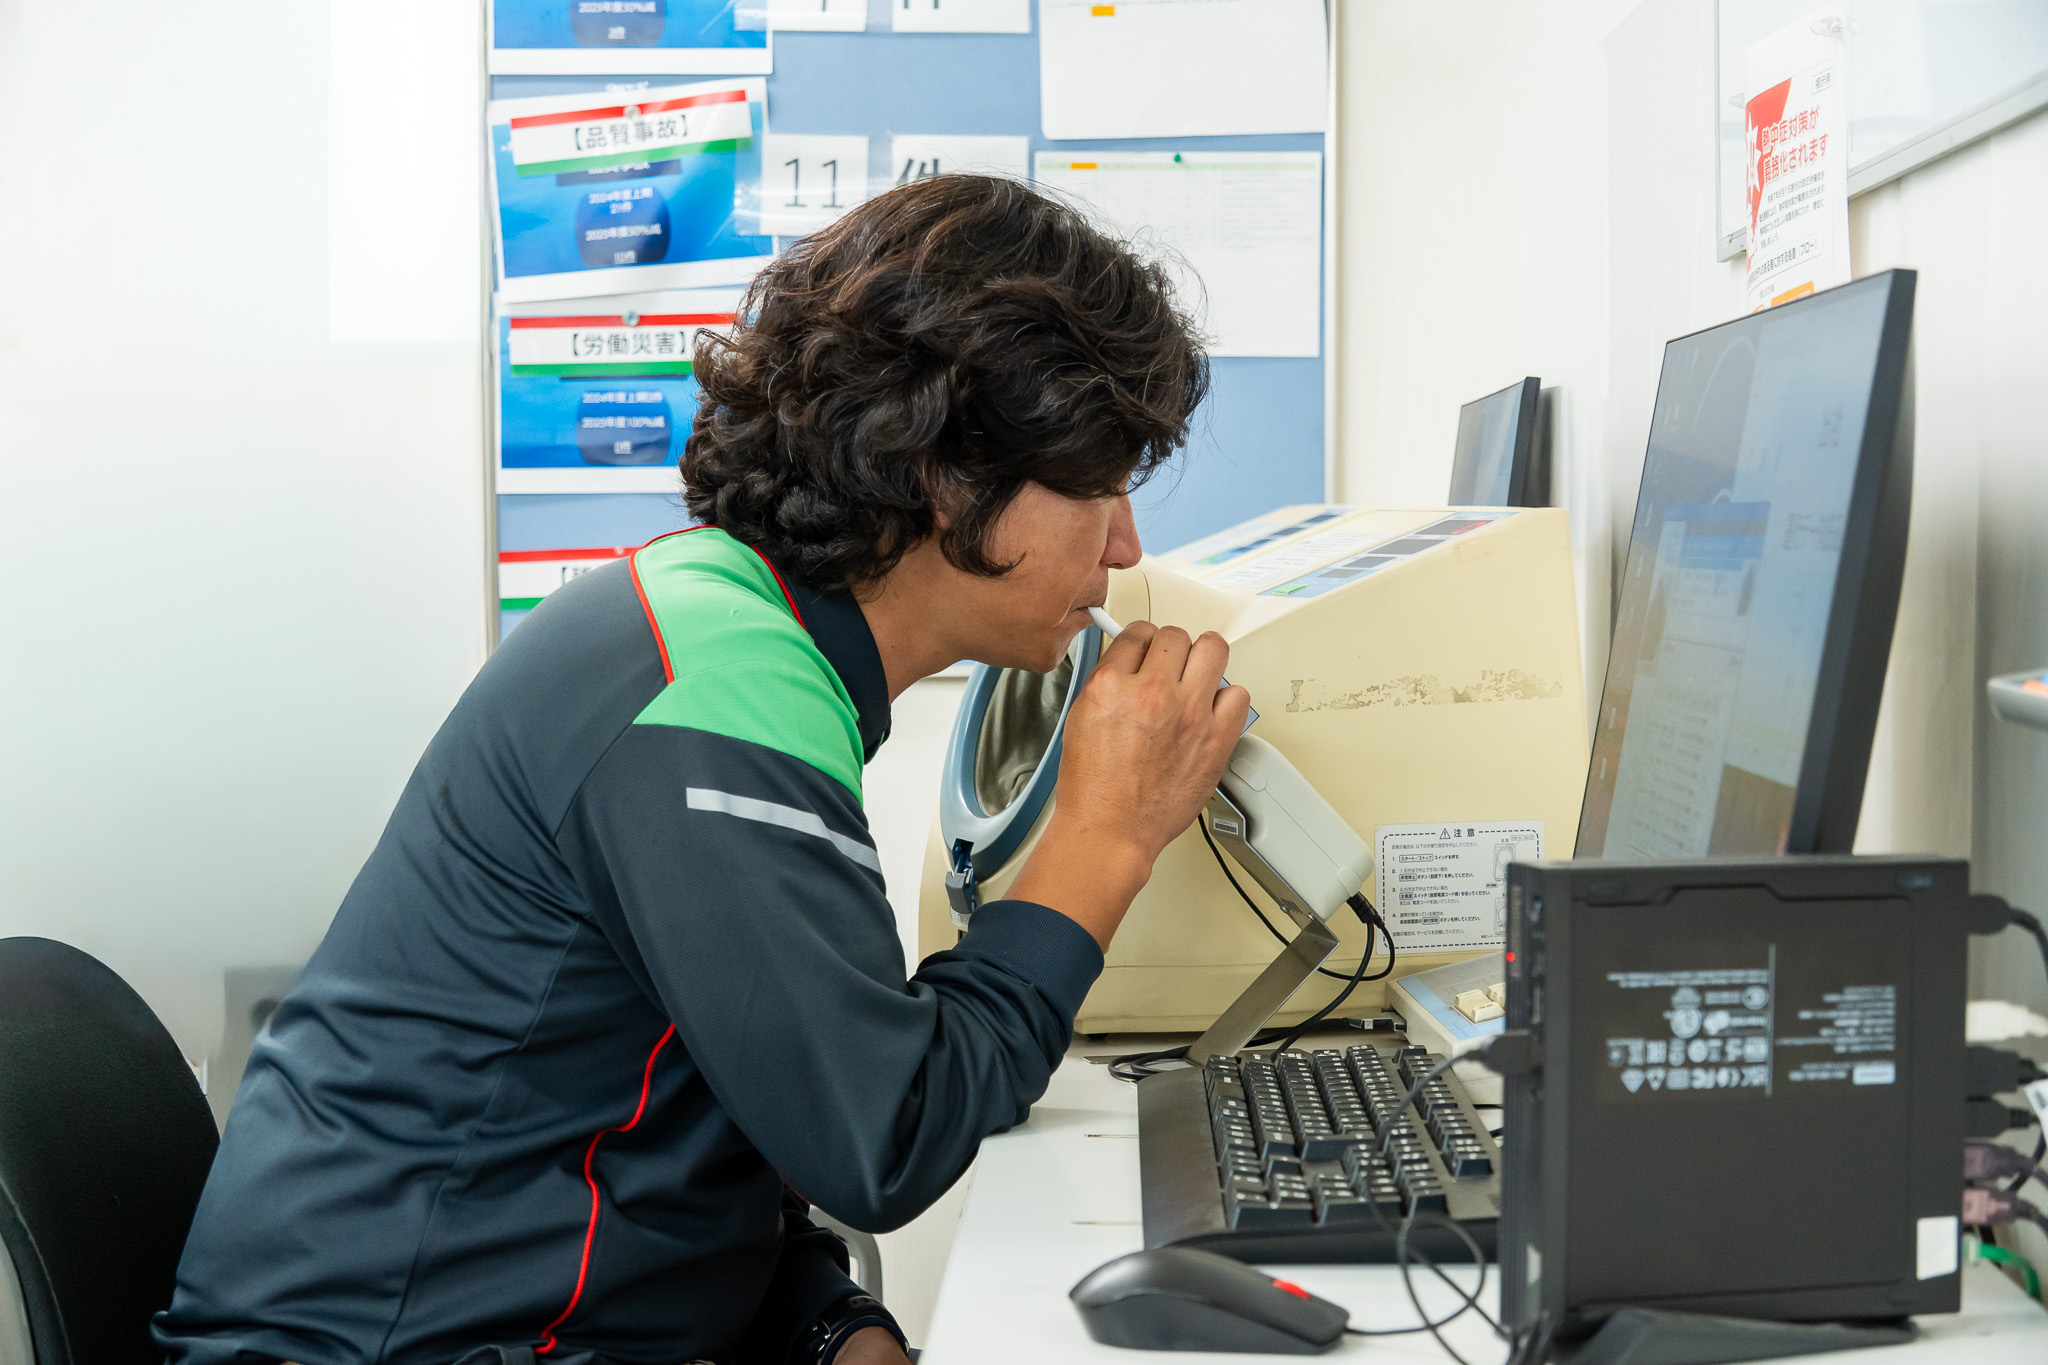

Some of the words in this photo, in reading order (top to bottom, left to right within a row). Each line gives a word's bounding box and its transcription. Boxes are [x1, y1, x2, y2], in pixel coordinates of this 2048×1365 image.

[573, 113, 690, 152] 【品質事故】
[1762, 104, 1820, 153] 熱中症対策が
[1764, 133, 1828, 183] 義務化されます
[784, 157, 843, 208] 11
[570, 330, 687, 356] 【労働災害】
[1453, 828, 1475, 837] 注意
